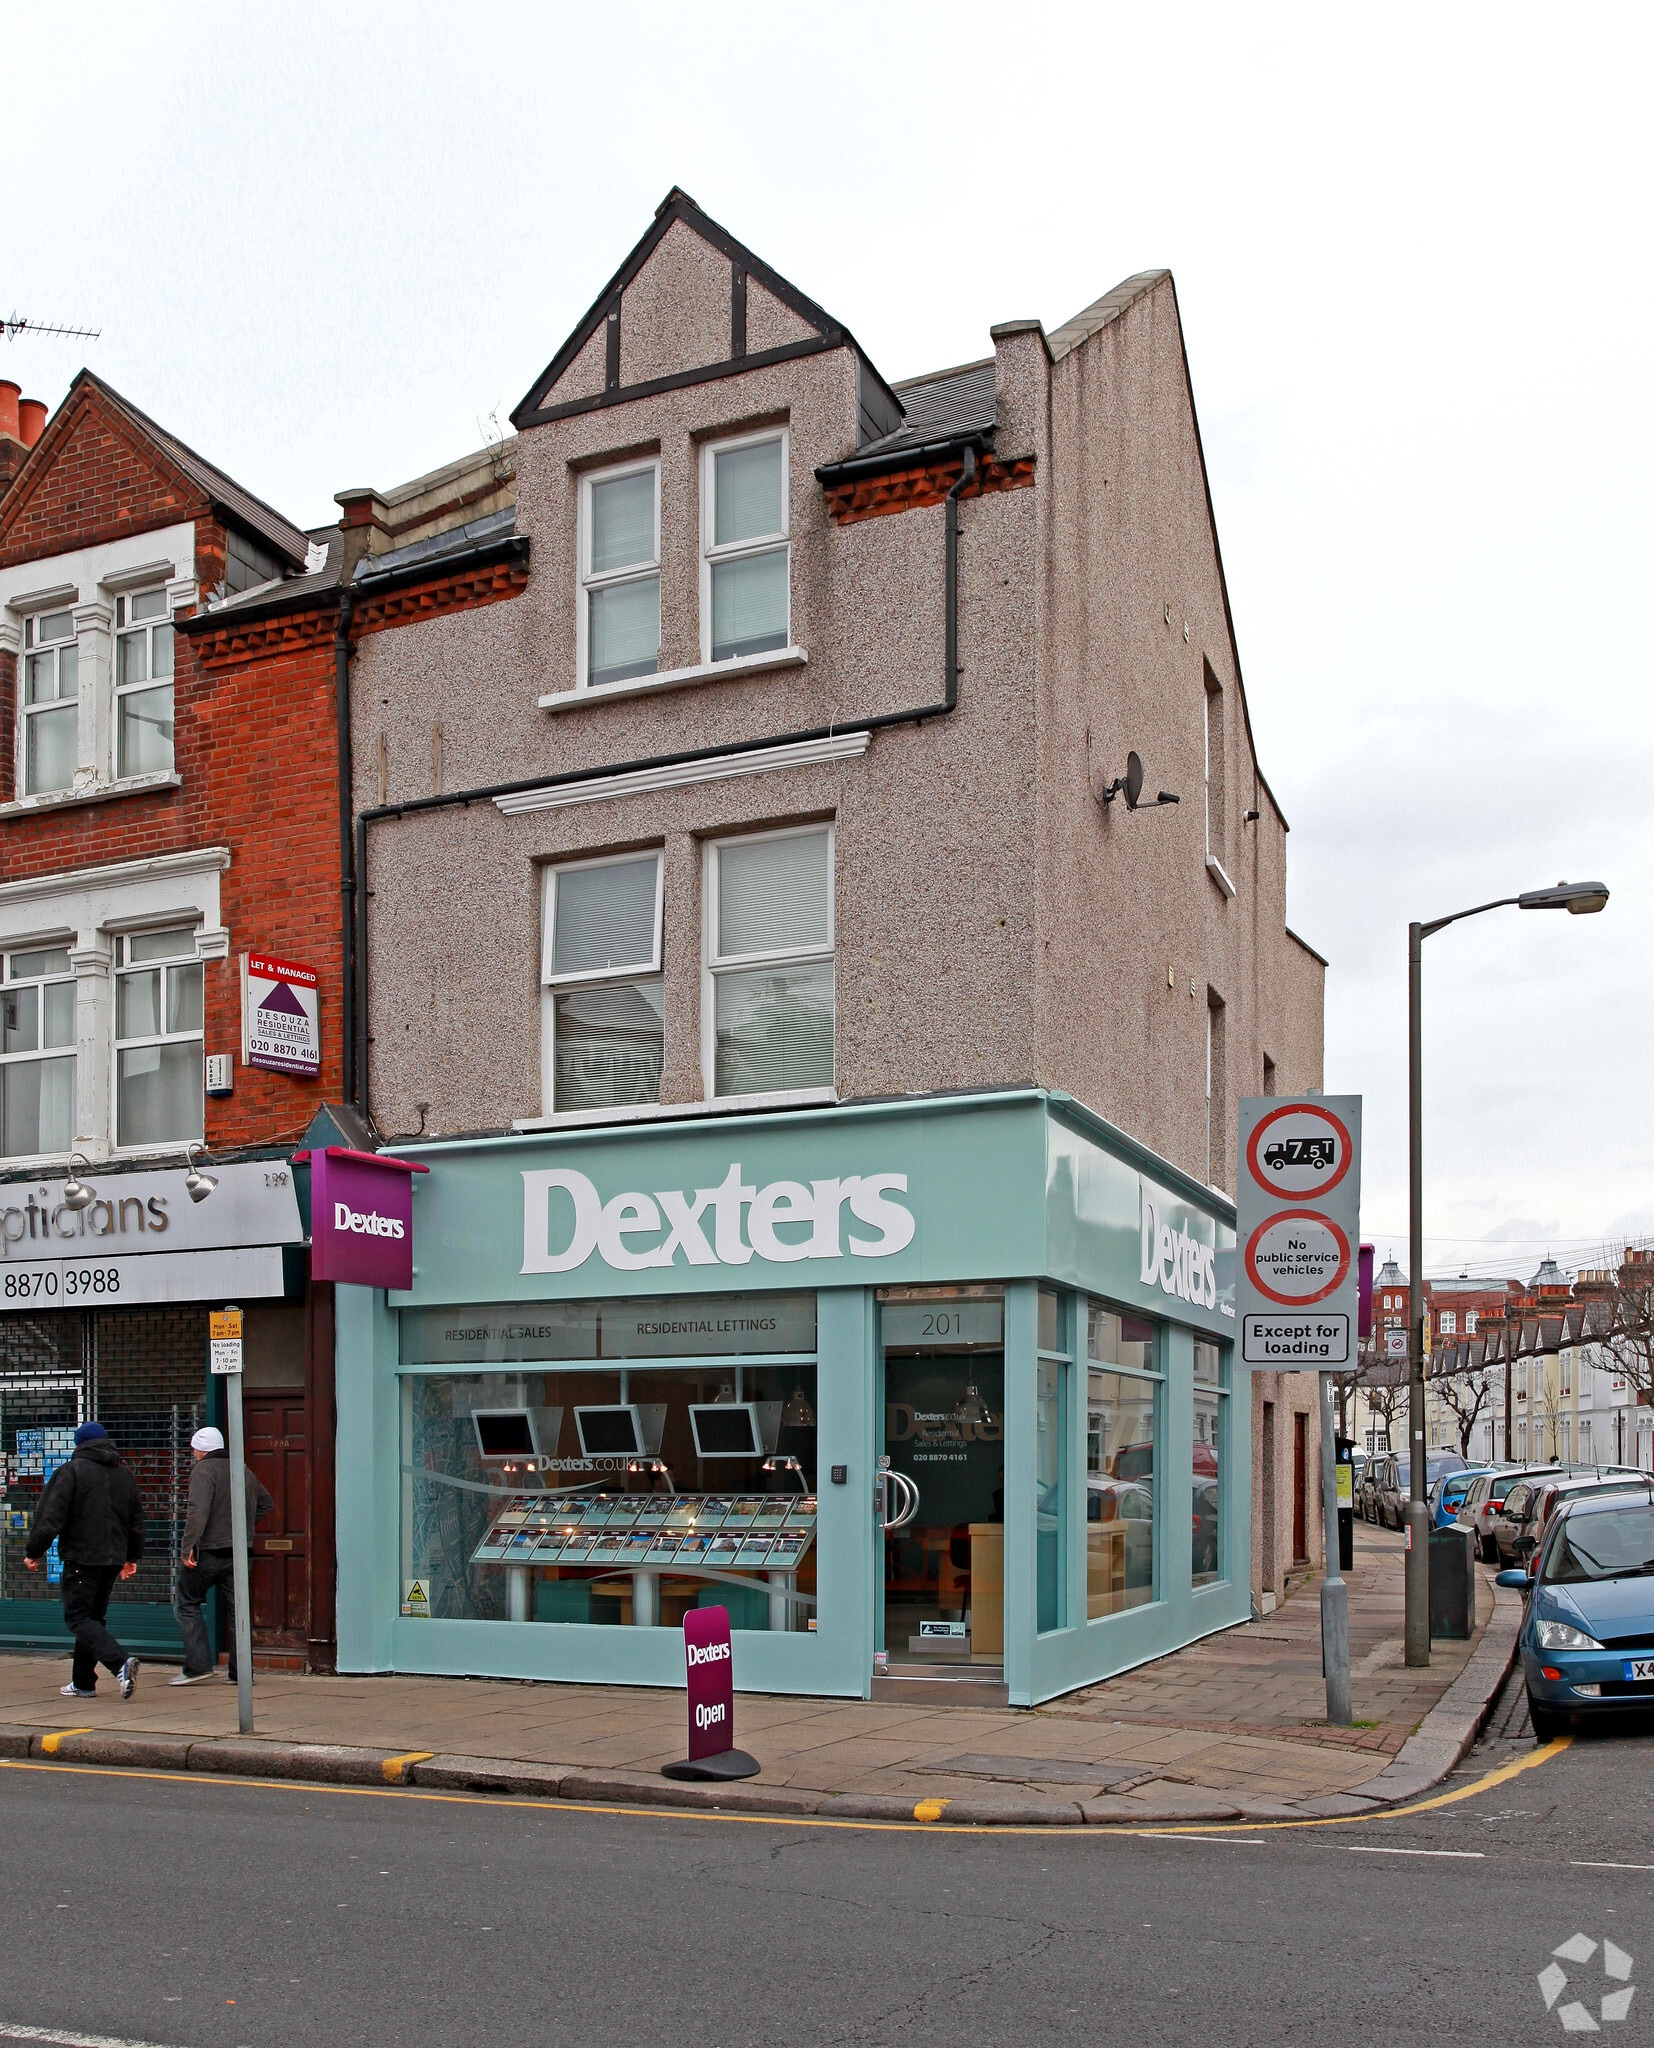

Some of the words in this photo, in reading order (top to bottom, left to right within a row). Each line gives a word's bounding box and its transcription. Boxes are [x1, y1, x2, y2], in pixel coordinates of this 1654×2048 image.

[251, 960, 264, 969] LET
[268, 964, 274, 972] &
[277, 966, 316, 982] MANAGED
[257, 1010, 309, 1026] DESOUZA
[257, 1018, 310, 1034] RESIDENTIAL
[258, 1028, 276, 1036] SALES
[284, 1033, 310, 1042] LETTINGS
[251, 1040, 269, 1051] 020
[274, 1044, 296, 1056] 8870
[301, 1048, 317, 1060] 4161
[252, 1056, 317, 1072] desouzaresidential.com
[334, 1201, 404, 1239] Dexters
[519, 1163, 916, 1274] Dexters
[1140, 1184, 1216, 1311] Dexters
[1288, 1240, 1306, 1250] No
[1256, 1252, 1293, 1264] public
[1296, 1252, 1339, 1262] service
[1273, 1264, 1323, 1275] vehicles
[5, 1272, 58, 1298] 8870
[65, 1268, 120, 1294] 3988
[637, 1320, 712, 1335] RESIDENTIAL
[716, 1318, 776, 1332] LETTINGS
[922, 1313, 960, 1336] 201
[1254, 1325, 1312, 1340] Except
[1316, 1324, 1340, 1337] for
[445, 1329, 515, 1340] RESIDENTIAL
[518, 1326, 552, 1338] SALES
[1265, 1341, 1330, 1356] loading
[914, 1412, 966, 1421] Dexters.co.uk
[940, 1440, 967, 1449] Lettings
[538, 1455, 634, 1472] Dexters.co.uk
[687, 1642, 730, 1667] Dexters
[696, 1703, 725, 1731] Open
